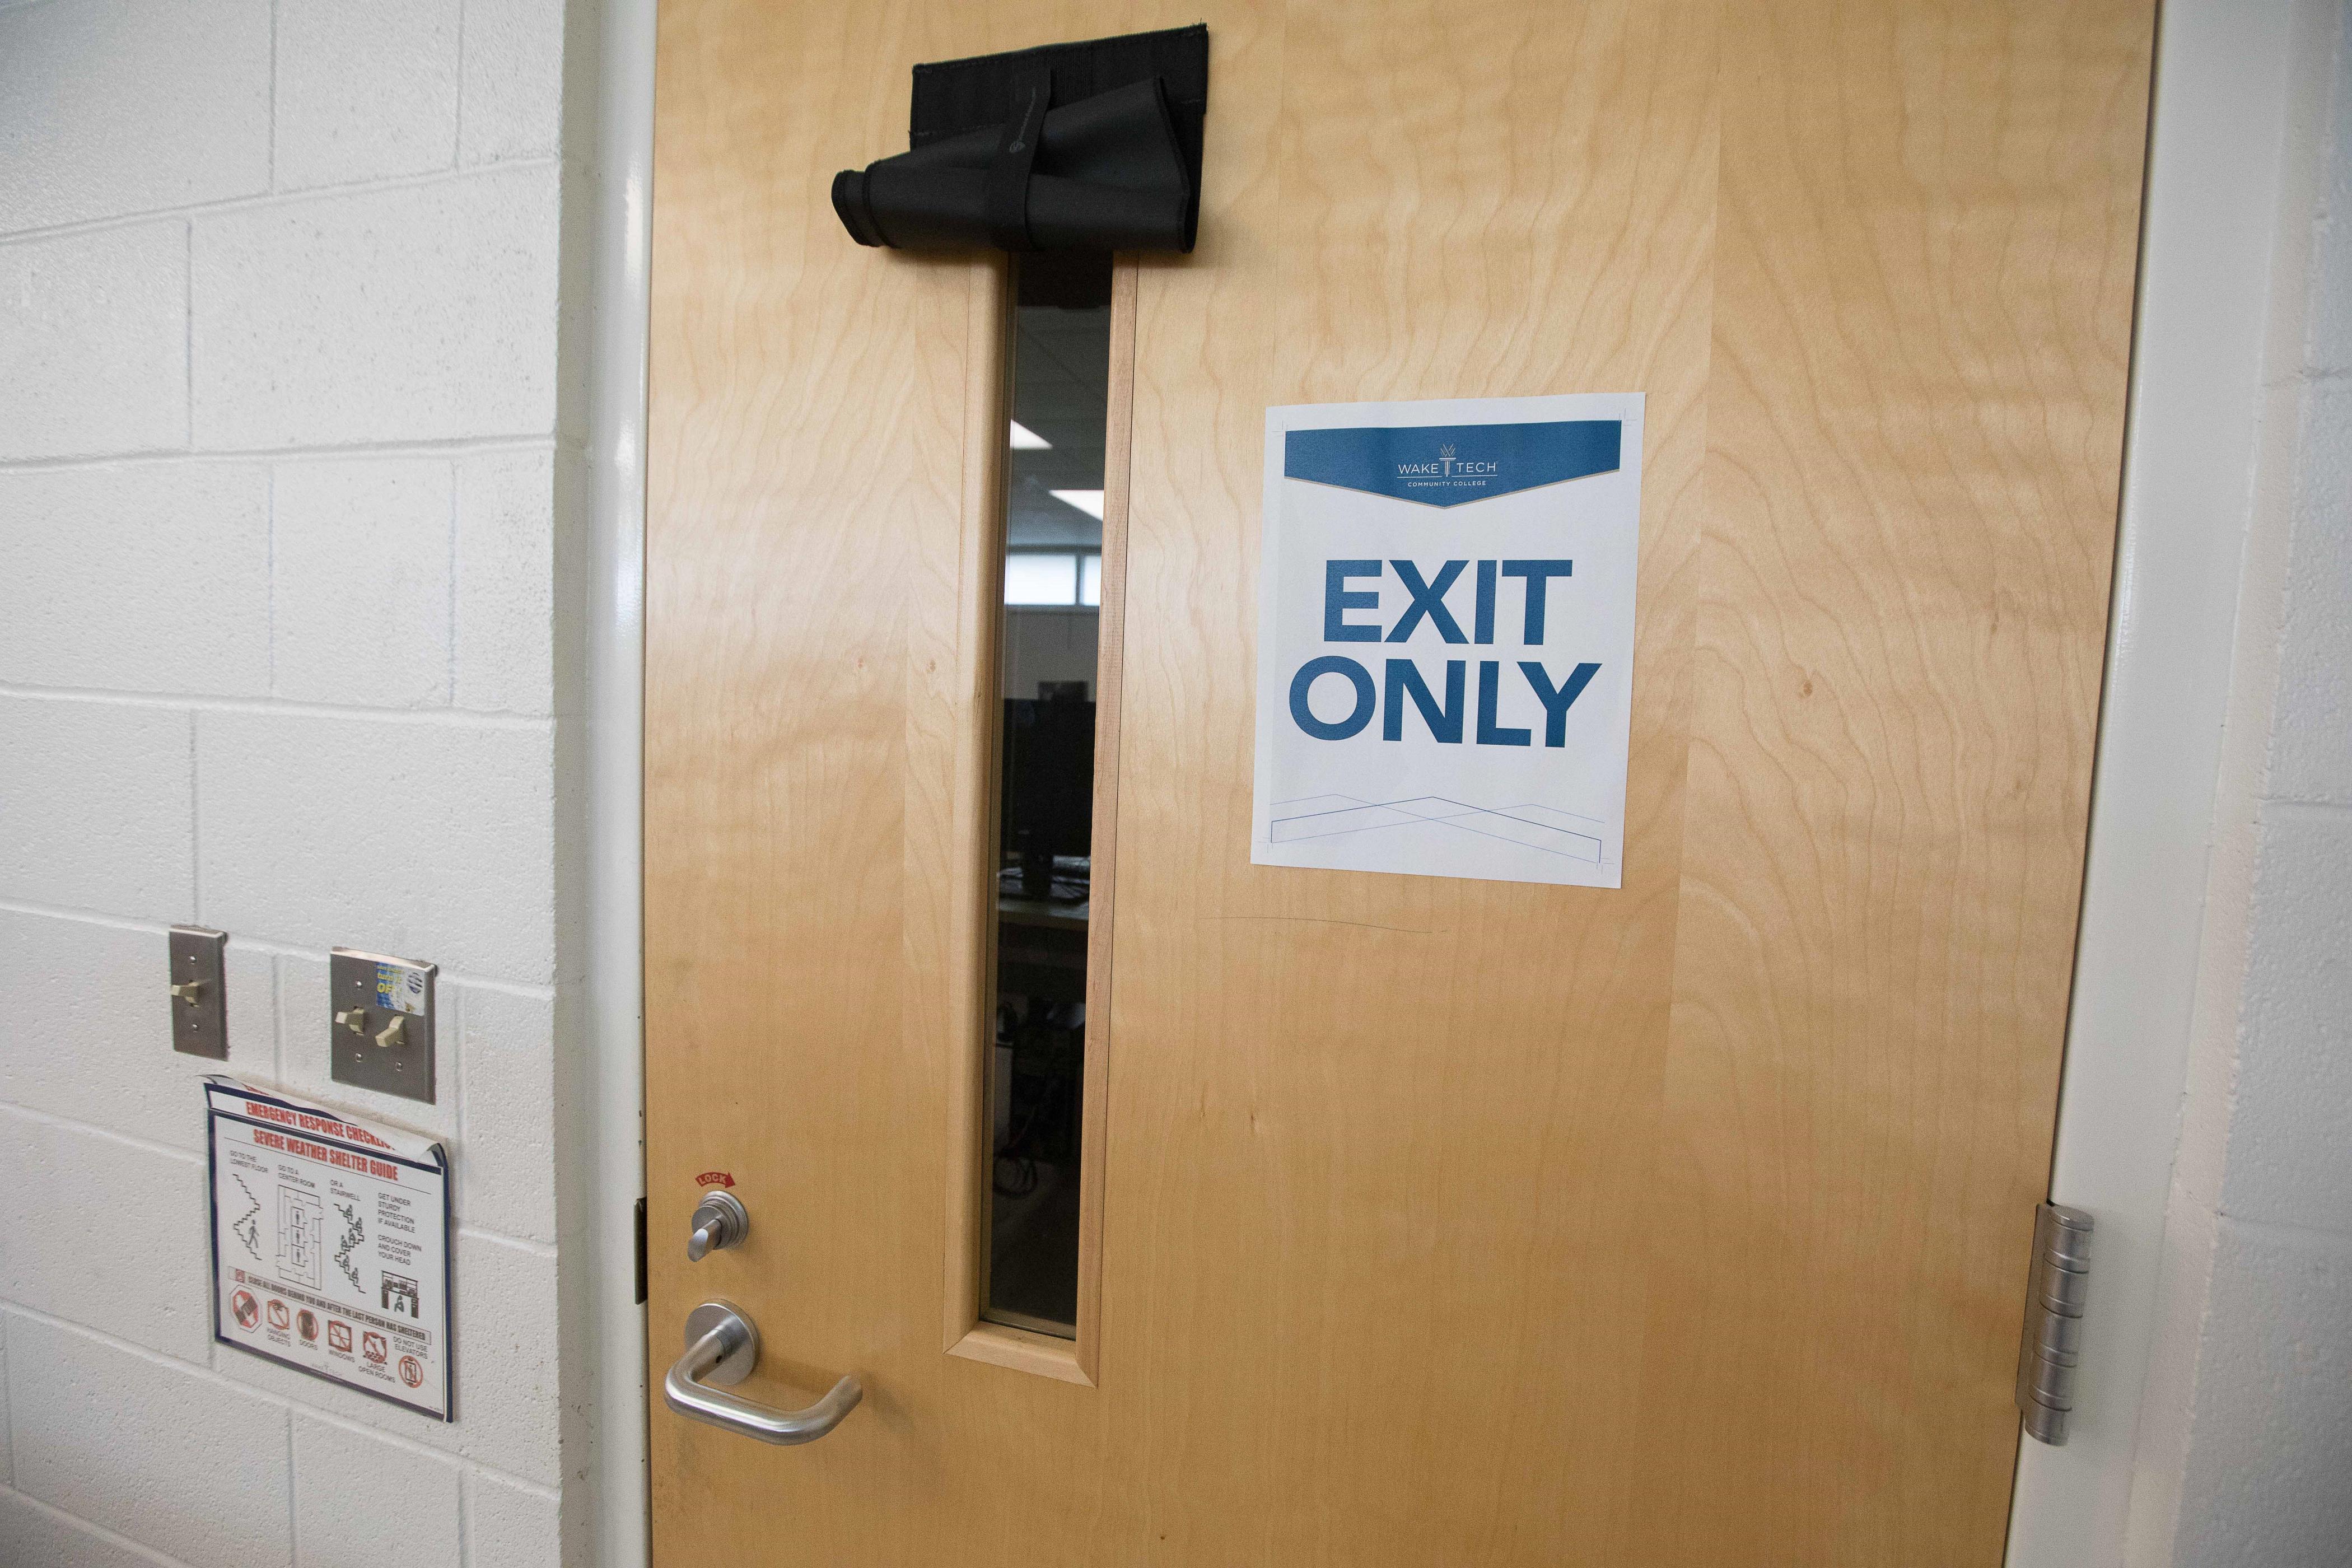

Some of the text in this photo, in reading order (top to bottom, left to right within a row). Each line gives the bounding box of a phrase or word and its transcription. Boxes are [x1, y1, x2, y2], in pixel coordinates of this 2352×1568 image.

[1398, 461, 1496, 474] WAKE TECH
[1323, 559, 1573, 646] EXIT
[1289, 655, 1603, 748] ONLY
[246, 1101, 297, 1126] EMERGENCY
[298, 1113, 345, 1138] RESPONSE
[253, 1128, 399, 1181] SEVERE WEATHER SHELTER GUIDE
[299, 1178, 315, 1188] ROOM
[697, 1173, 727, 1185] LOCK
[330, 1188, 361, 1201] STAIRWELL
[391, 1196, 412, 1206] UNDER
[377, 1201, 401, 1212] STURDY
[377, 1209, 415, 1225] PROTECTION
[384, 1219, 416, 1234] AVAILABLE
[377, 1234, 422, 1252] CROUCH DOWN
[377, 1243, 412, 1257] AND COVER
[377, 1251, 412, 1266] YOUR HEAD
[327, 1302, 341, 1313] AFTER
[342, 1306, 351, 1317] THE
[352, 1310, 364, 1321] LAST
[365, 1314, 386, 1328] PERSON
[386, 1321, 396, 1332] HAS
[397, 1324, 426, 1341] SHELTERED
[393, 1336, 428, 1353] DO NOT USE
[394, 1343, 428, 1360] ELEVATORS
[329, 1350, 356, 1363] WINDOWS
[358, 1365, 374, 1376] OPEN
[375, 1370, 396, 1383] ROOMS
[366, 1361, 386, 1373] LARGE
